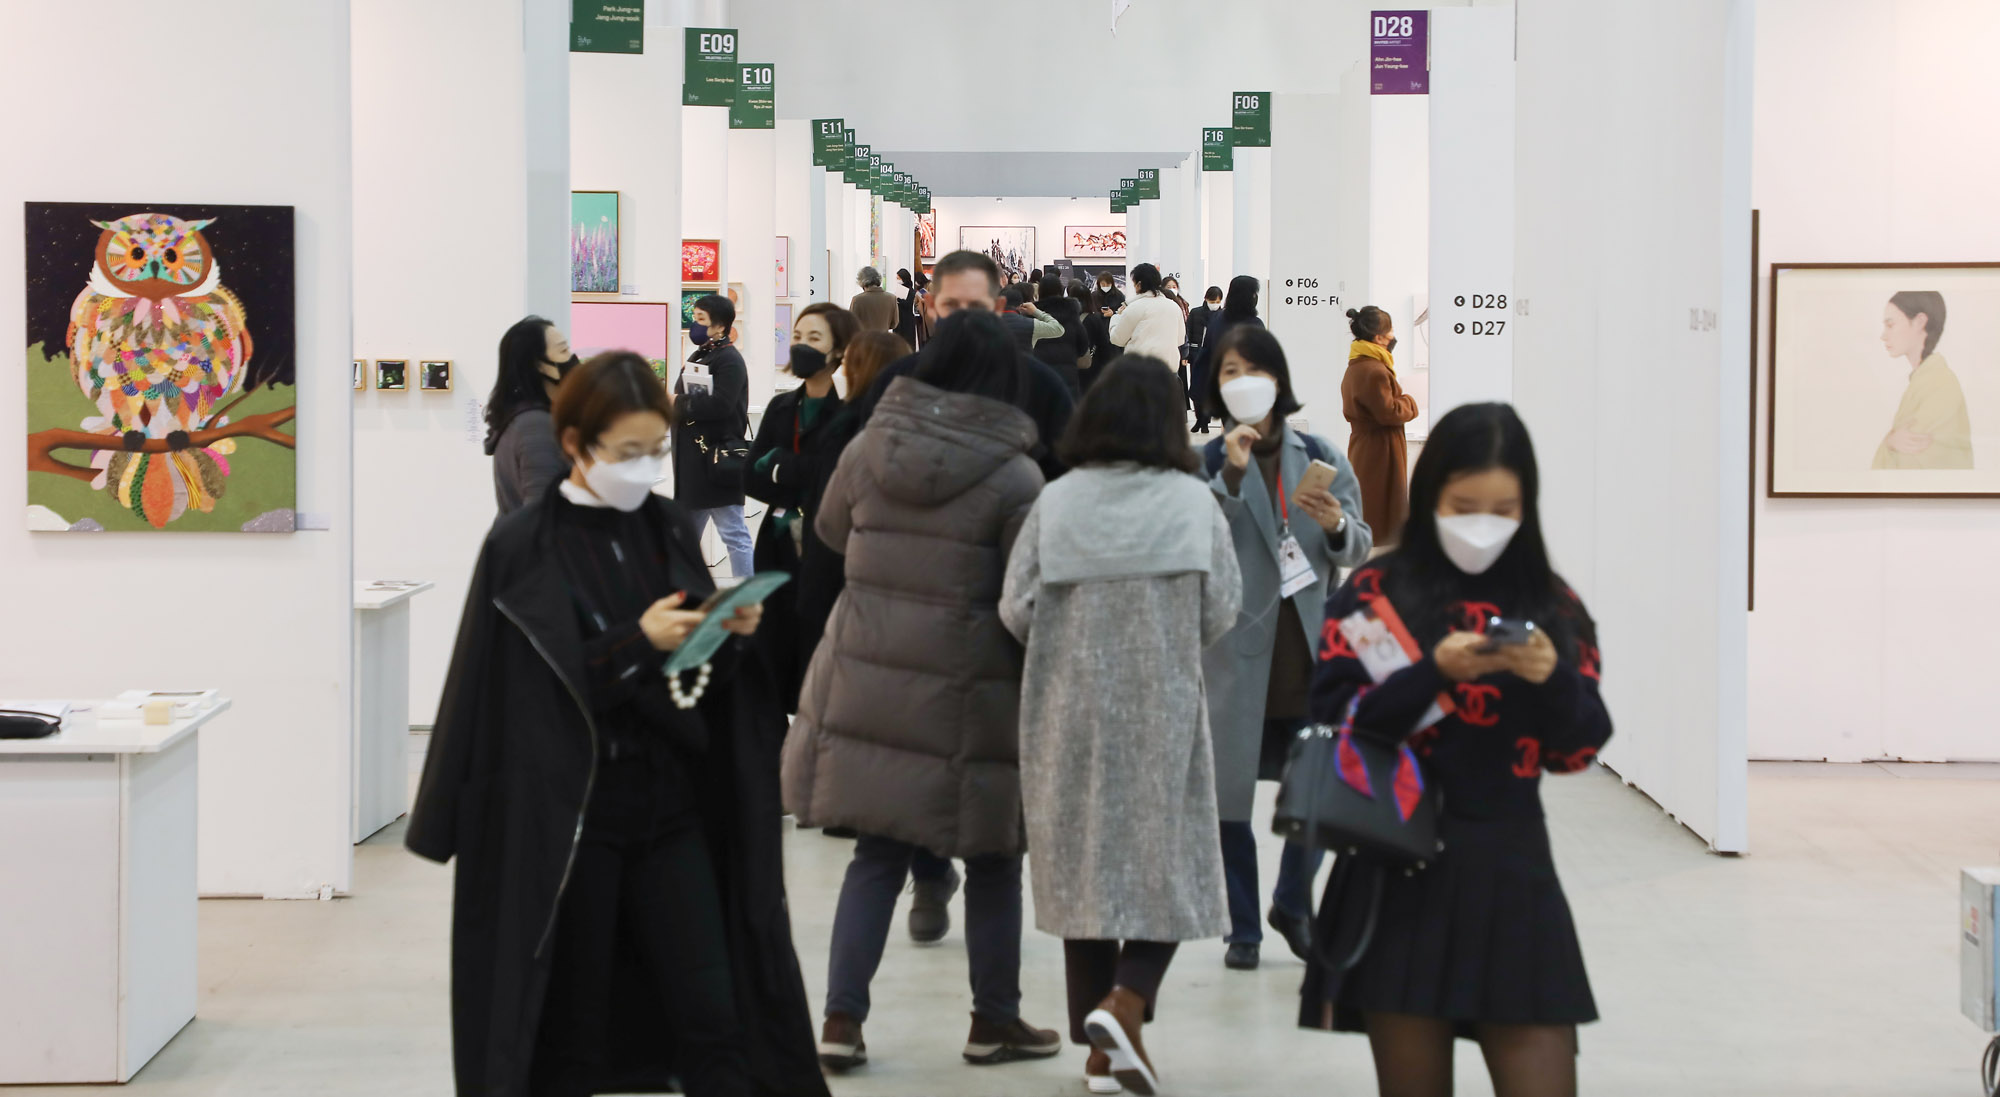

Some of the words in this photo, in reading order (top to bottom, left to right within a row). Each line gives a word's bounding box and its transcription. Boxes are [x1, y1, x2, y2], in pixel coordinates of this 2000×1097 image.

[1374, 16, 1413, 37] D28
[700, 33, 734, 54] E09
[742, 67, 772, 84] E10
[1235, 95, 1259, 110] F06
[821, 122, 842, 134] E11
[1204, 130, 1224, 142] F16
[1139, 171, 1154, 179] G16
[1121, 180, 1135, 188] G15
[1297, 278, 1319, 288] F06
[1297, 295, 1318, 306] F05
[1472, 294, 1507, 309] D28
[1472, 321, 1506, 335] D27
